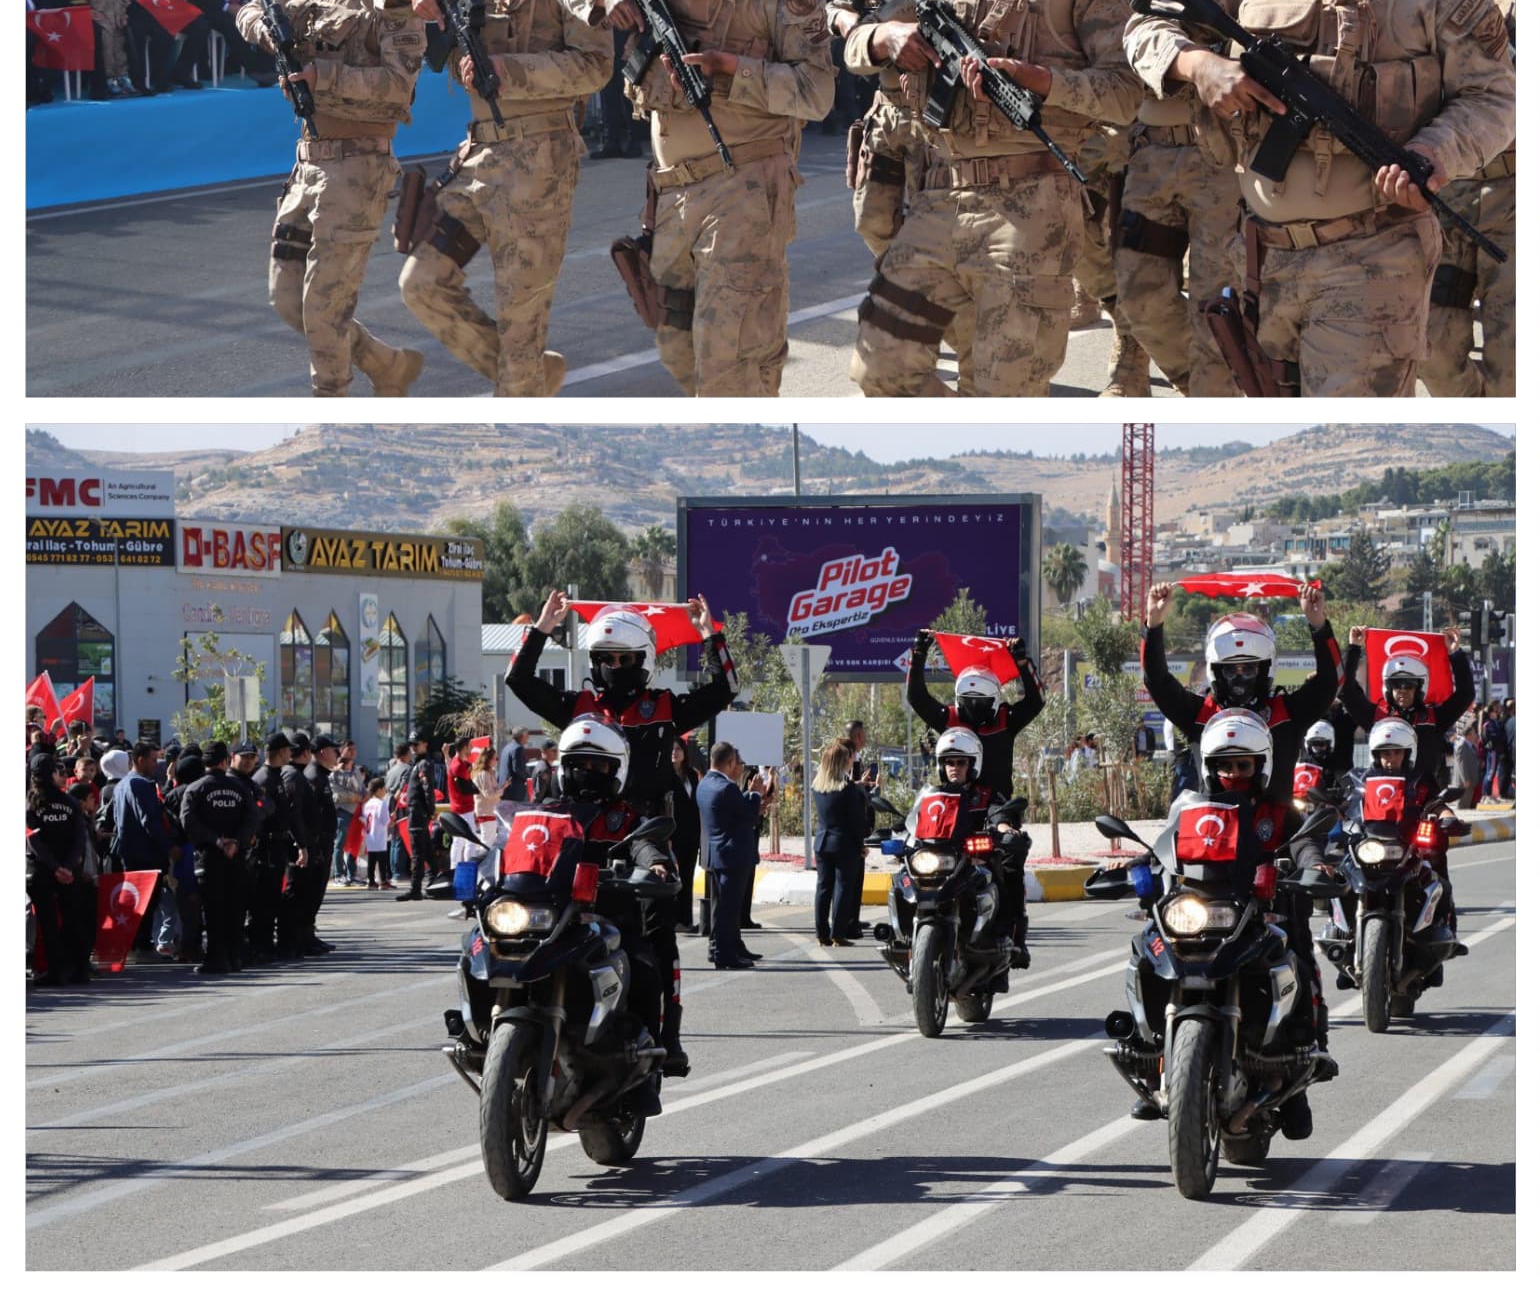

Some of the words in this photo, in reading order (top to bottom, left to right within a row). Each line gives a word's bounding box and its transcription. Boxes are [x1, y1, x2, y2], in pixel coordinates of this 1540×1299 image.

[118, 483, 156, 492] Agricultural
[139, 493, 170, 502] Company
[29, 520, 90, 537] AYAZ
[99, 521, 169, 538] TARIM
[125, 541, 163, 552] Gübre
[310, 537, 367, 568] AYAZ
[371, 540, 439, 573] TARIM
[820, 550, 897, 591] Pilot
[789, 577, 911, 622] Garage
[811, 611, 869, 632] Ekspertiz
